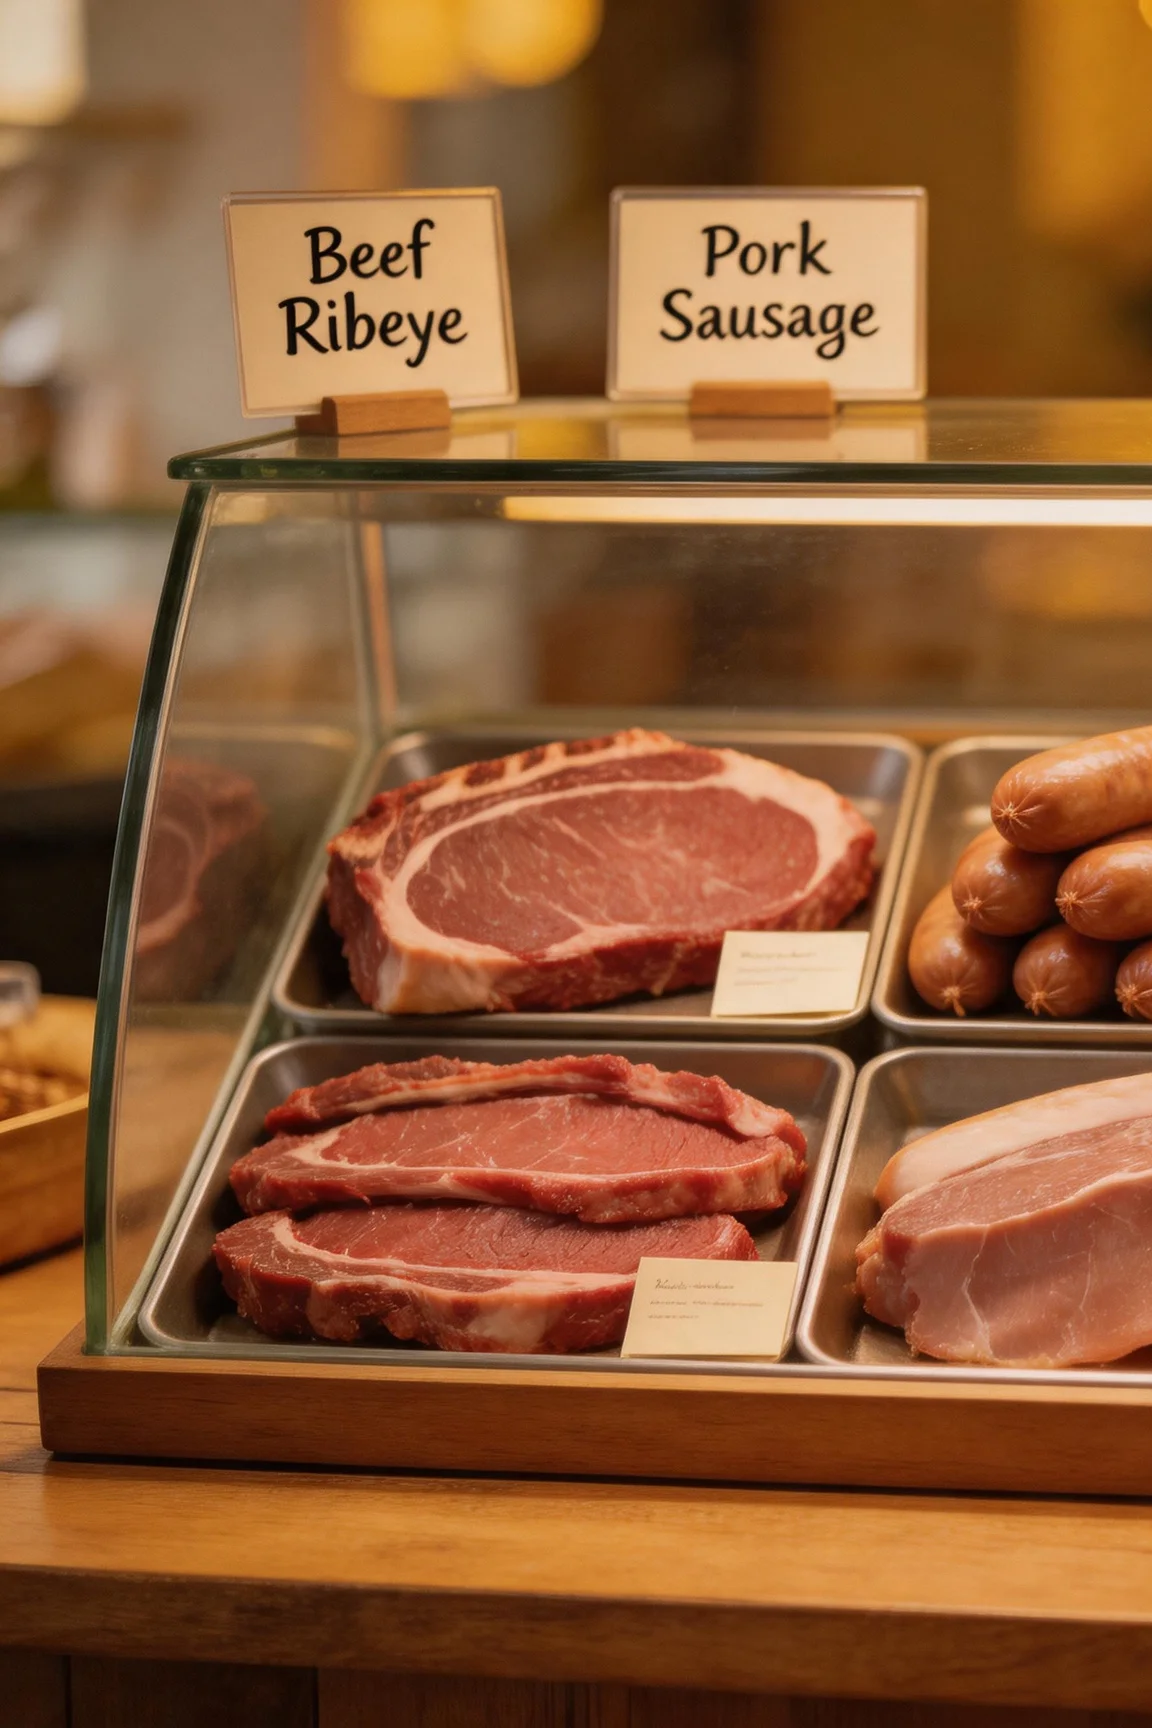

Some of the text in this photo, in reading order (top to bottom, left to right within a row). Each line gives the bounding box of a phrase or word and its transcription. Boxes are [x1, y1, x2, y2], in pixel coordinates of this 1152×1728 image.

[303, 217, 436, 285] Beef
[701, 220, 832, 278] Pork
[277, 290, 468, 369] Ribeye
[659, 288, 879, 362] Sausage
